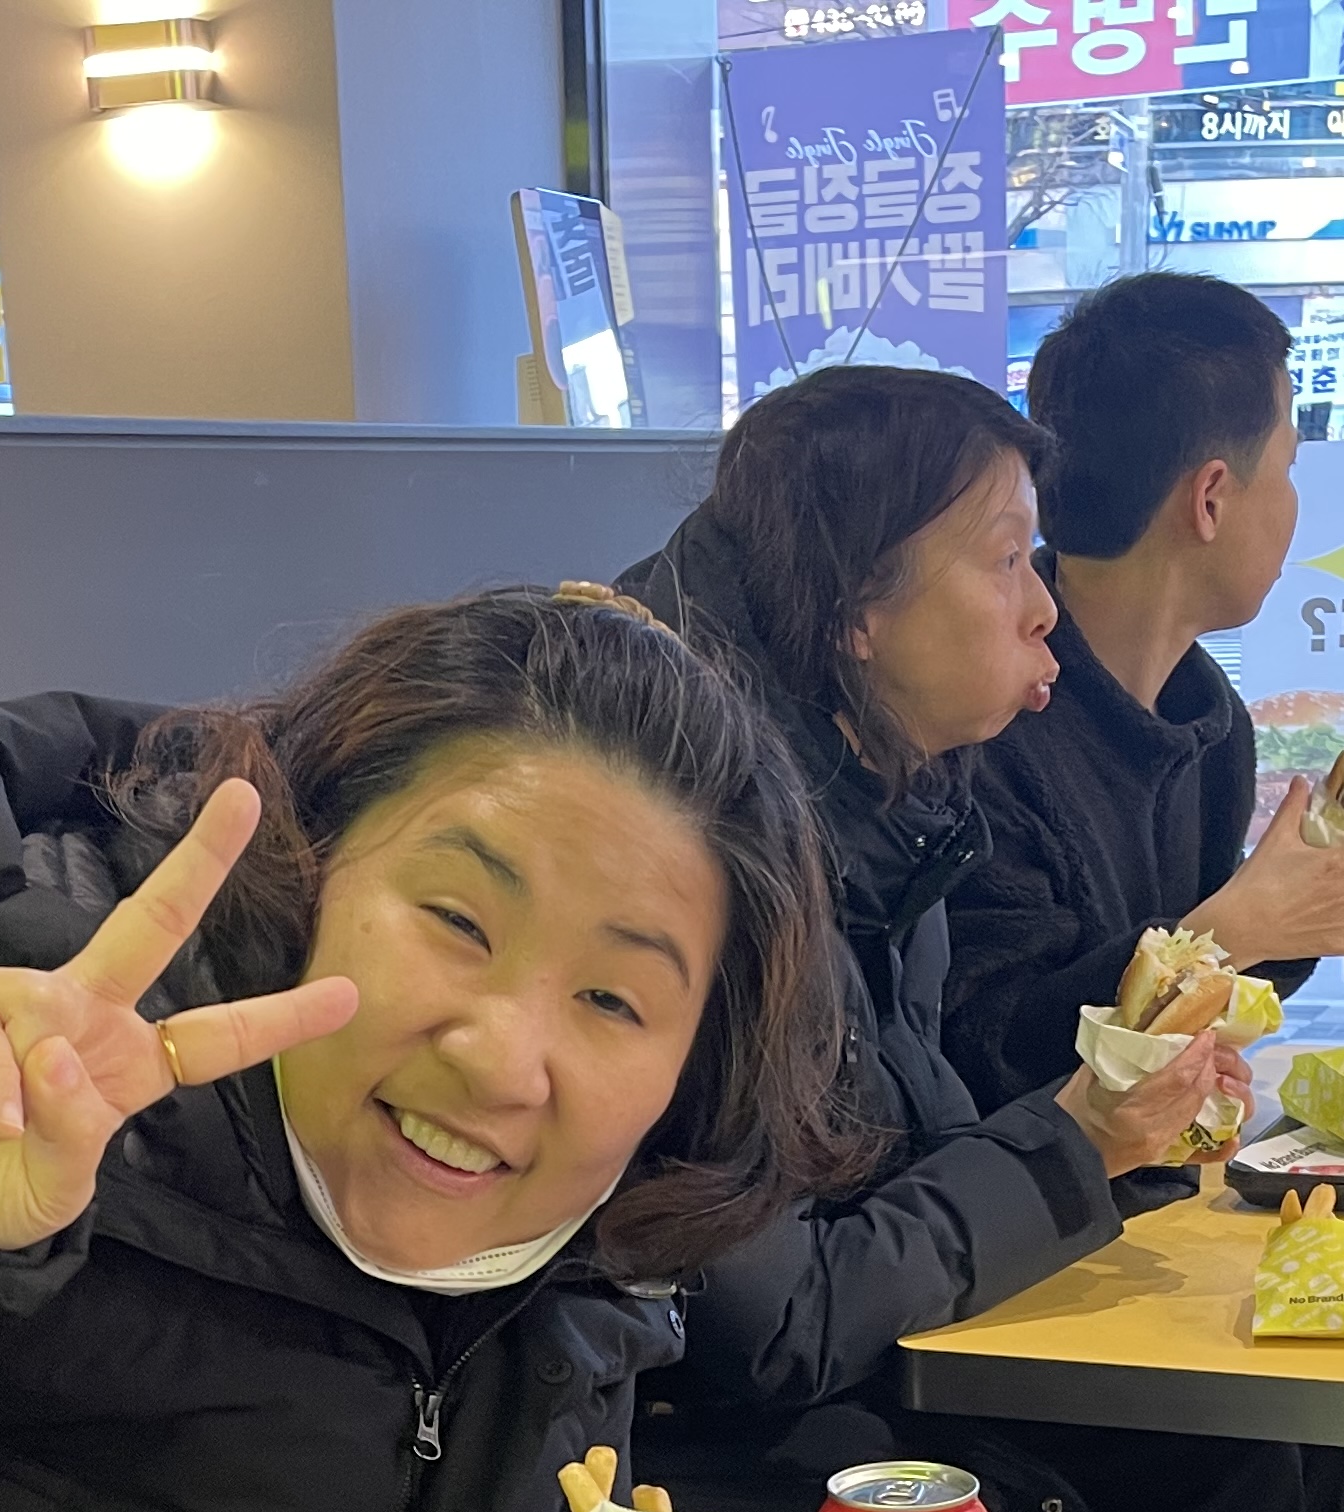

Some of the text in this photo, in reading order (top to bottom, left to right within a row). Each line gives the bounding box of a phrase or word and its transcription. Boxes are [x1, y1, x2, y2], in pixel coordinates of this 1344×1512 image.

[1201, 109, 1290, 140] 8시까지
[1289, 1295, 1306, 1305] No
[1308, 1293, 1344, 1304] Brand
